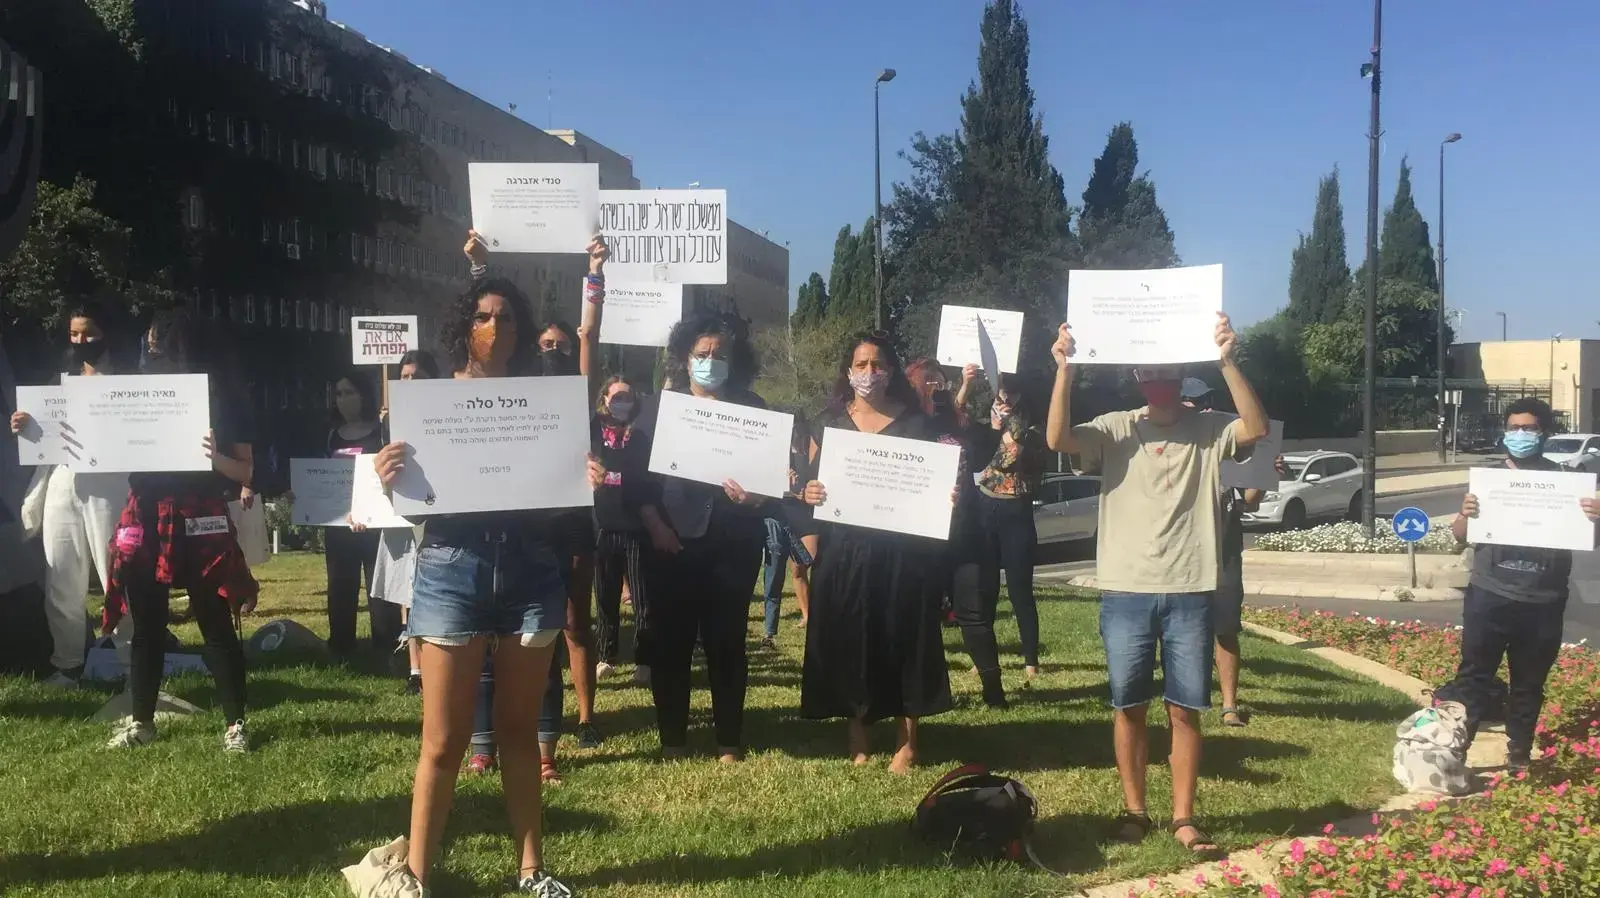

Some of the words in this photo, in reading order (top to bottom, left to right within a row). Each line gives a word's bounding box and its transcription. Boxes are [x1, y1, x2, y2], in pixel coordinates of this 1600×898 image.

[506, 177, 539, 185] אזברגה
[541, 177, 561, 185] סנדי
[654, 198, 685, 231] ישראל
[688, 232, 704, 263] כל
[364, 331, 383, 343] את
[362, 343, 408, 355] מפחדת
[110, 390, 149, 401] ווישניאק
[152, 390, 176, 398] מאיה
[466, 397, 494, 409] סלה
[497, 395, 528, 408] מיכל
[715, 412, 741, 423] אחמד
[742, 420, 768, 429] אימאן
[866, 448, 889, 458] צגאיי
[891, 451, 925, 463] סילבנה
[1509, 480, 1532, 489] מנאע
[1534, 482, 1556, 490] היבה
